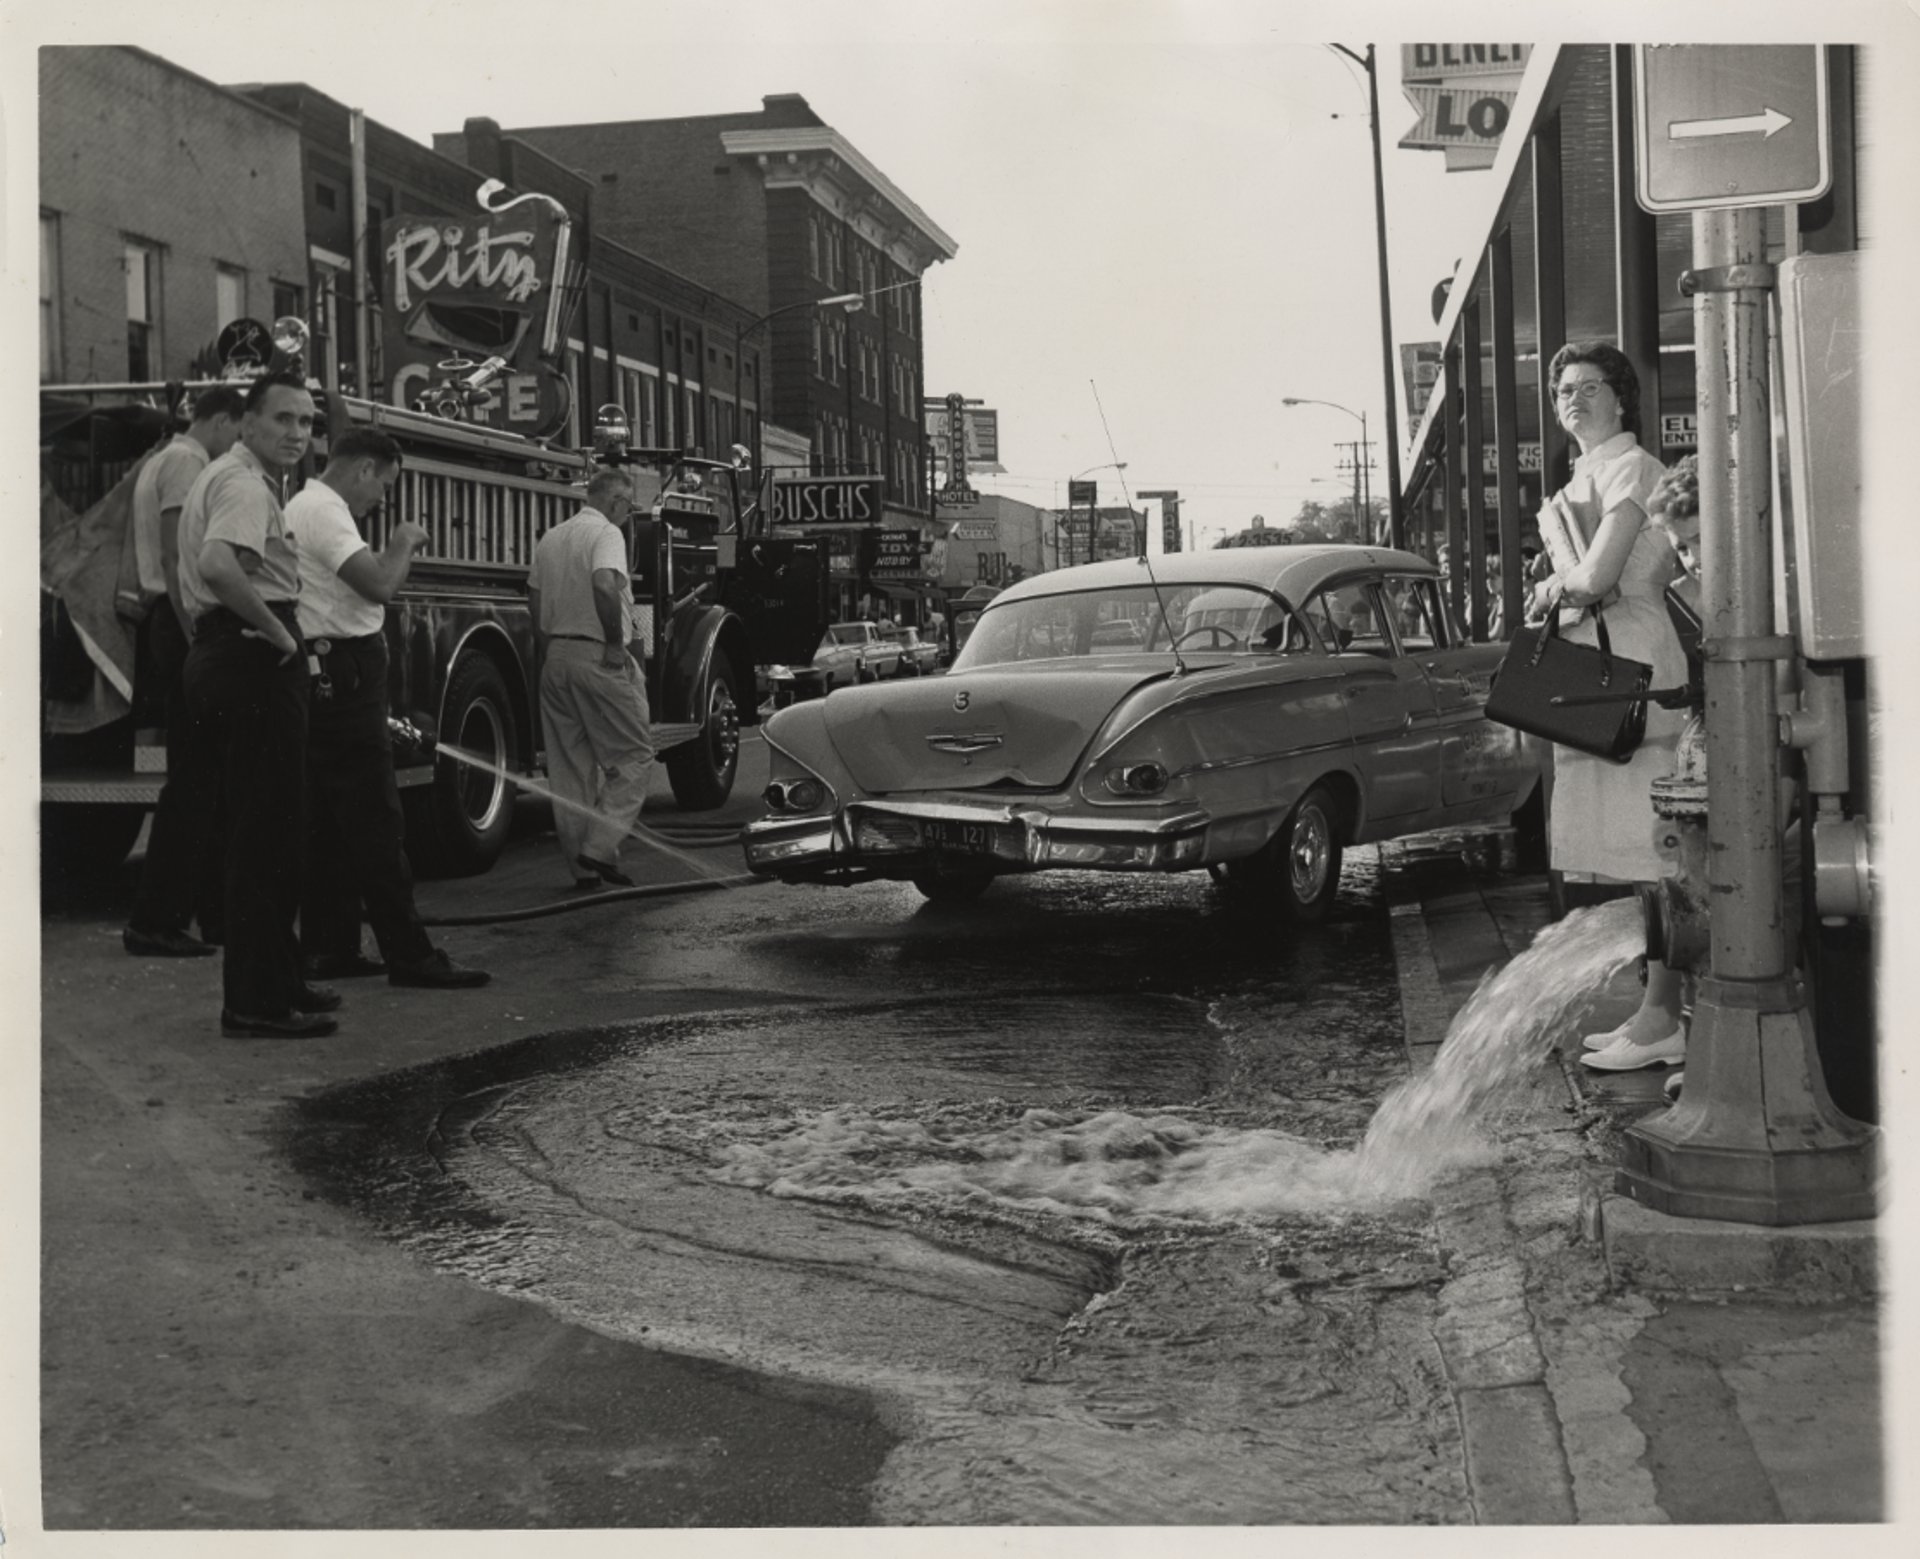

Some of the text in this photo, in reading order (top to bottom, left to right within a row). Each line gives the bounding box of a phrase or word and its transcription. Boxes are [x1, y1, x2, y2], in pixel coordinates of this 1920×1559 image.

[1435, 95, 1509, 138] LO
[386, 226, 541, 312] Ritz
[393, 363, 540, 422] CFE
[1665, 433, 1697, 443] ENT
[772, 484, 871, 522] BUSCHS
[942, 491, 976, 502] HOTEL
[953, 690, 970, 713] 3
